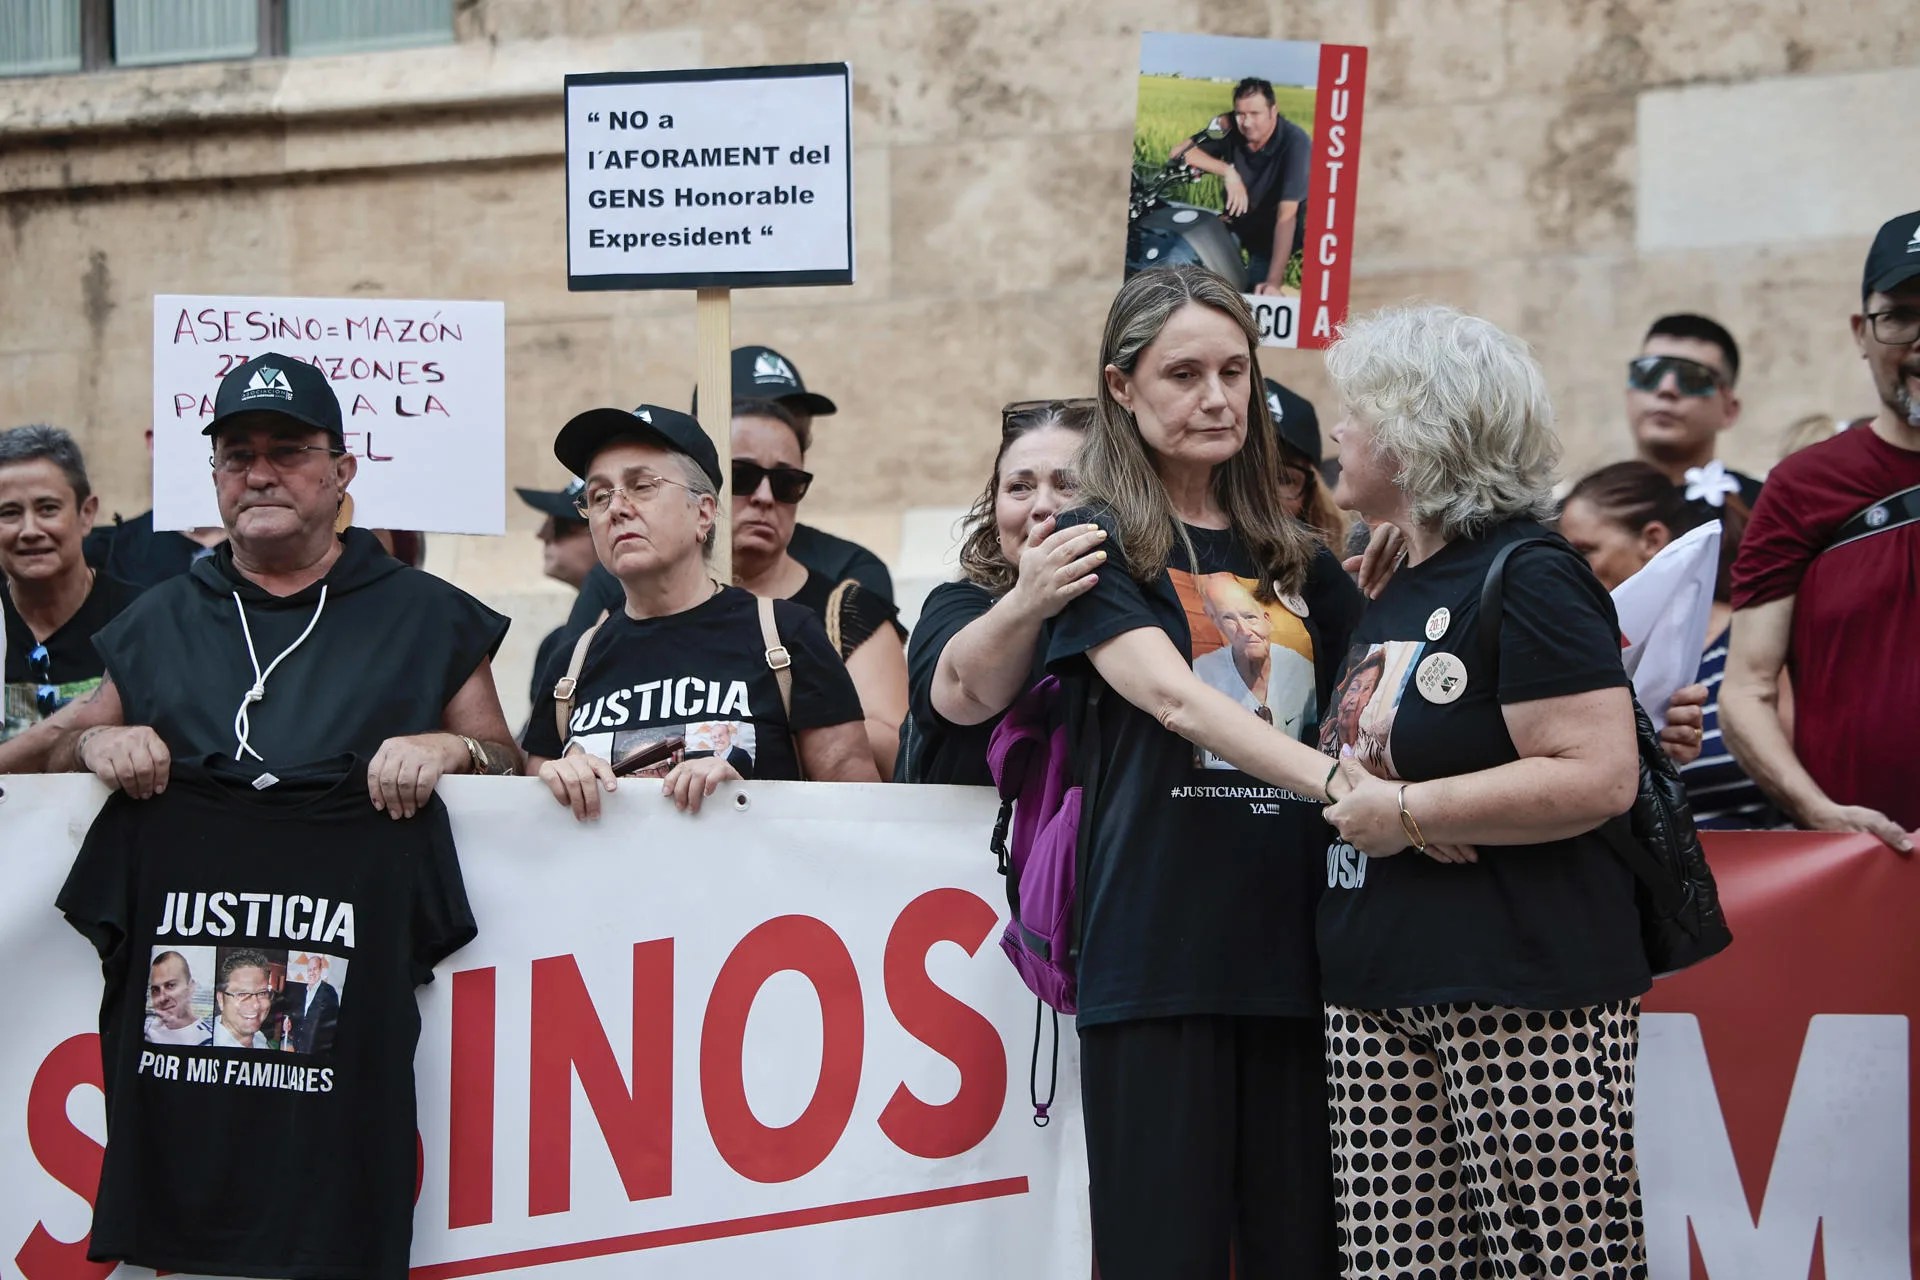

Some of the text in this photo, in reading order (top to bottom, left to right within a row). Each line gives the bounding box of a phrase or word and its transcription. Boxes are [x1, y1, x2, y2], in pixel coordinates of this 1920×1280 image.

[609, 110, 649, 130] NO
[658, 114, 674, 129] a
[789, 145, 830, 165] del
[588, 185, 814, 209] GENS Honorable
[1312, 53, 1349, 338] JUSTICIA
[588, 227, 751, 252] Expresident
[290, 354, 445, 384] AZONES
[352, 394, 378, 416] A
[395, 395, 450, 418] LA
[156, 891, 355, 949] JUSTICIA
[138, 1050, 334, 1093] POR MIS FAMILIARES
